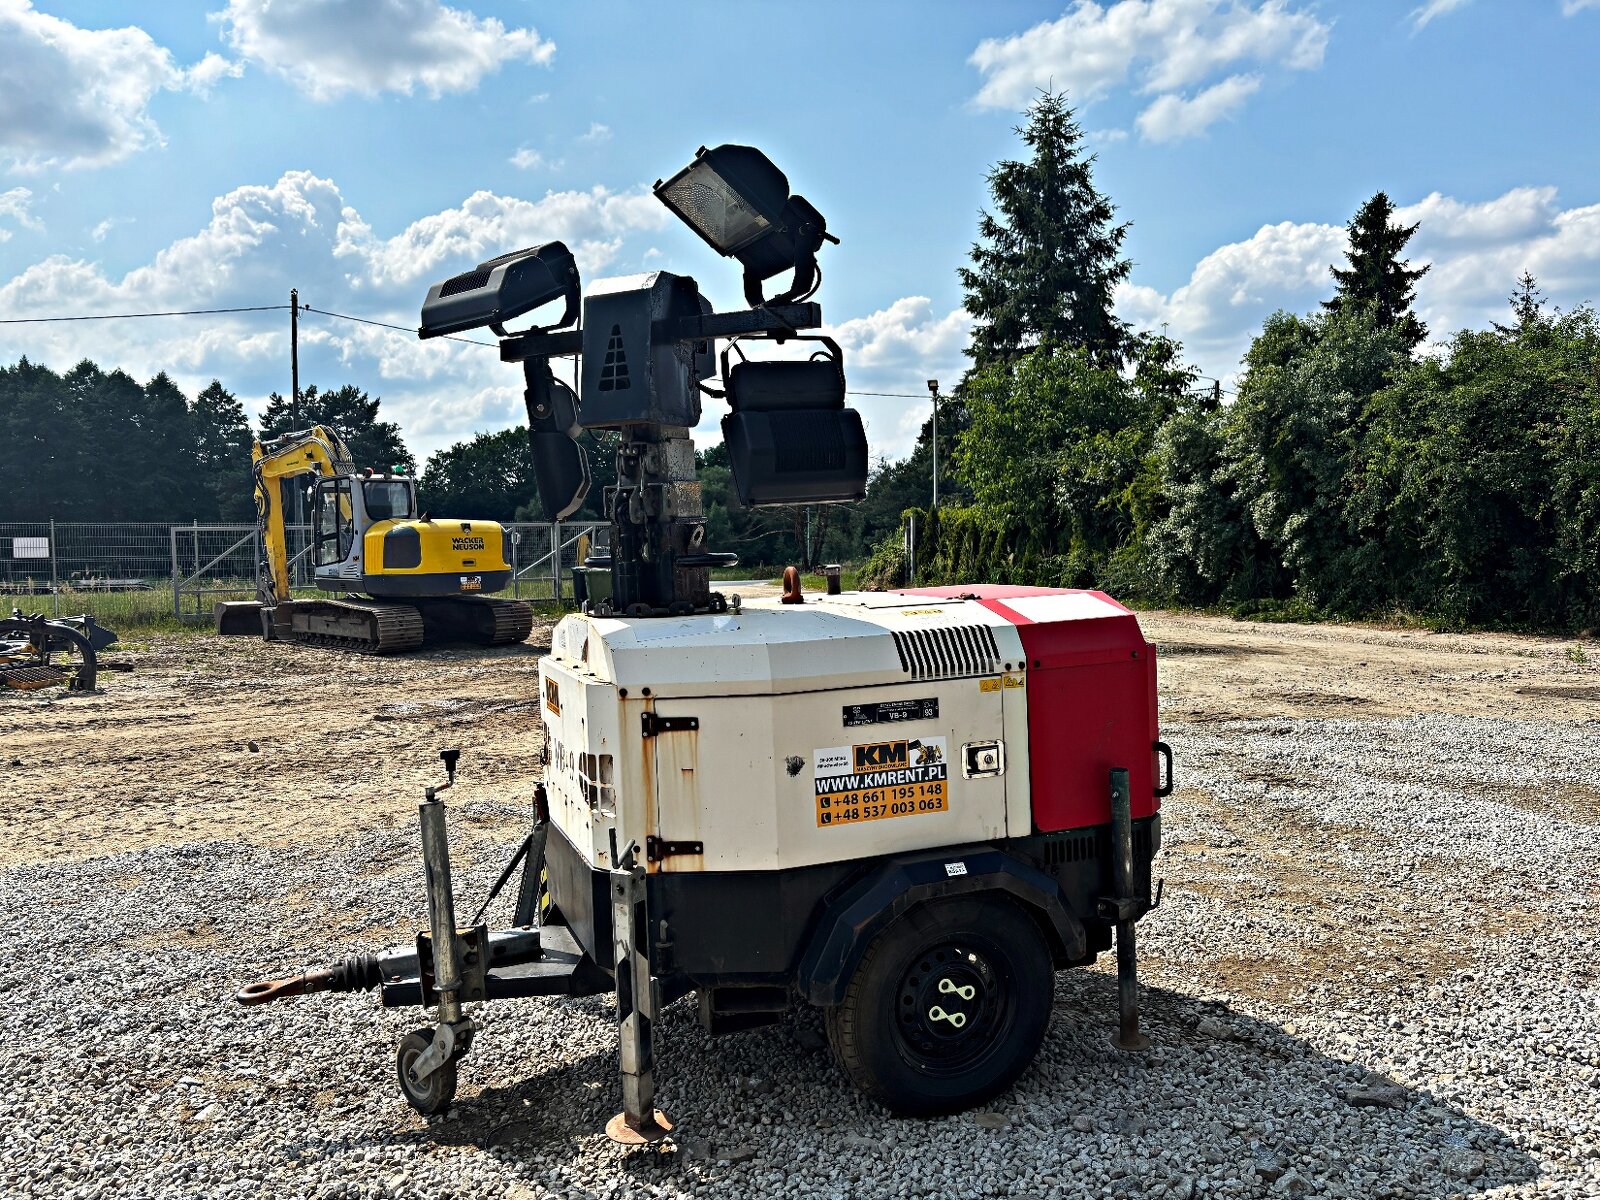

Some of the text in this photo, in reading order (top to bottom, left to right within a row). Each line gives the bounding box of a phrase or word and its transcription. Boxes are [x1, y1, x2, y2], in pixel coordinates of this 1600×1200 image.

[889, 711, 908, 719] VB-9
[924, 708, 933, 716] 93
[856, 742, 907, 767] KM
[816, 767, 945, 793] WWW.KMRENT.PL
[834, 784, 942, 807] +48 661 195 148
[834, 798, 942, 821] +48 537 003 063
